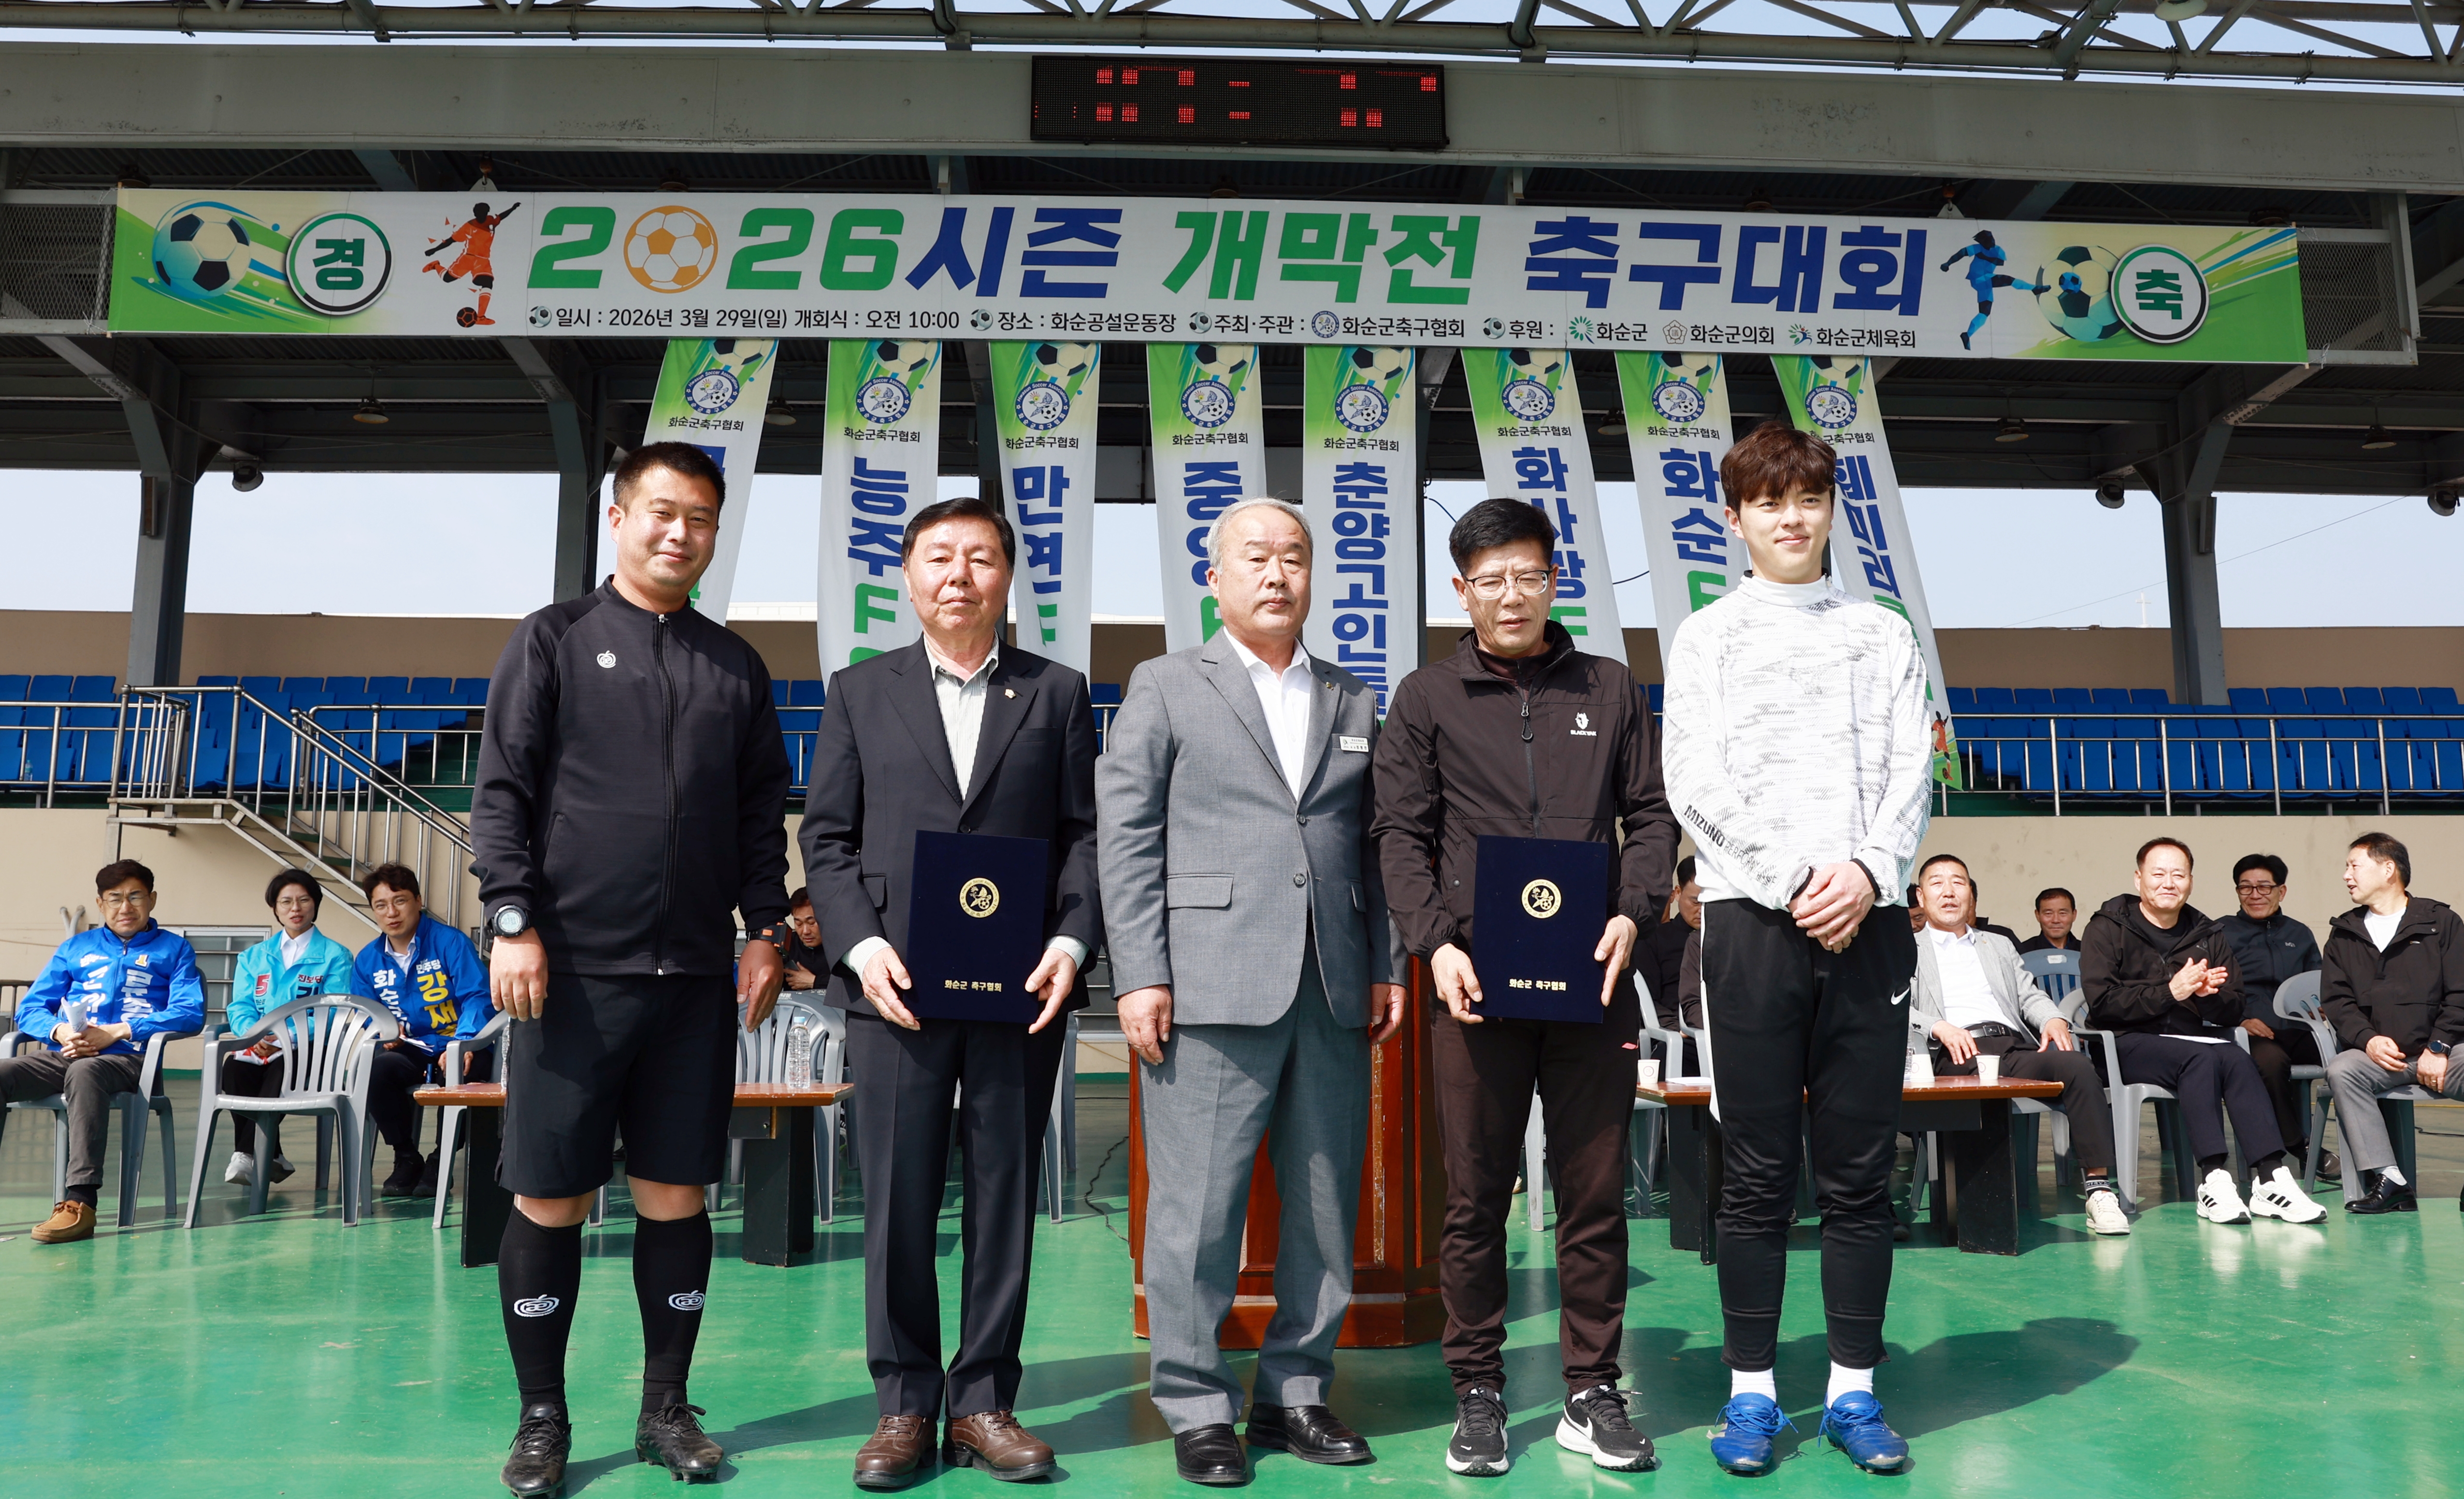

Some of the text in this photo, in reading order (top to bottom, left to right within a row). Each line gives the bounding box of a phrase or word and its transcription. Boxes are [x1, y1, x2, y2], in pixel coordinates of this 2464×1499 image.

[312, 237, 365, 291] 경
[1161, 210, 1481, 305] 개막전
[1524, 215, 1927, 316] 축구대회
[2135, 269, 2185, 320] 축
[556, 308, 591, 328] 일시
[609, 309, 673, 328] 2026년
[680, 309, 709, 328] 3월
[716, 309, 787, 329] 29일(일)
[794, 310, 848, 329] 개회식
[865, 310, 901, 329] 오전
[908, 311, 960, 329] 10:00
[997, 312, 1034, 331] 장소
[1051, 312, 1177, 334] 화순공설운동장
[1342, 316, 1465, 338] 화순군축구협회
[1509, 320, 1542, 340] 후원
[1596, 323, 1648, 343] 화순군
[1690, 325, 1774, 345] 화순군의회
[1816, 328, 1916, 349] 화순군체육회
[688, 373, 704, 387] Hwasun
[720, 371, 738, 389] Association
[858, 381, 873, 397] Hwasun
[889, 378, 909, 398] Association
[1017, 386, 1032, 402] Hwasun
[1048, 383, 1068, 403] Association
[1182, 385, 1196, 401] Hwasun
[1211, 381, 1233, 400] Association
[1337, 388, 1351, 404] Hwasun
[1366, 385, 1387, 406] Association
[1502, 382, 1514, 398] Hwasun
[1528, 381, 1552, 397] Association
[1653, 384, 1665, 400] Hwasun
[1680, 382, 1702, 400] Association
[1805, 389, 1816, 405] Hwasun
[1830, 386, 1854, 402] Association
[668, 416, 744, 432] 화순군축구협회
[1497, 426, 1572, 437] 화순군축구협회
[1647, 426, 1721, 440] 화순군축구협회
[843, 427, 921, 443] 화순군축구협회
[1005, 436, 1079, 450] 화순군축구협회
[1172, 432, 1249, 446] 화순군축구협회
[1809, 430, 1875, 445] 군축구협회
[1324, 437, 1399, 452] 화순군축구협회
[1684, 804, 1726, 847] MIZUNO
[416, 958, 442, 975] 민주당
[255, 973, 271, 997] 5
[297, 974, 324, 984] 진보당
[944, 979, 1002, 992] 화순군 축구협회
[1509, 978, 1567, 991] 화순군 축구협회
